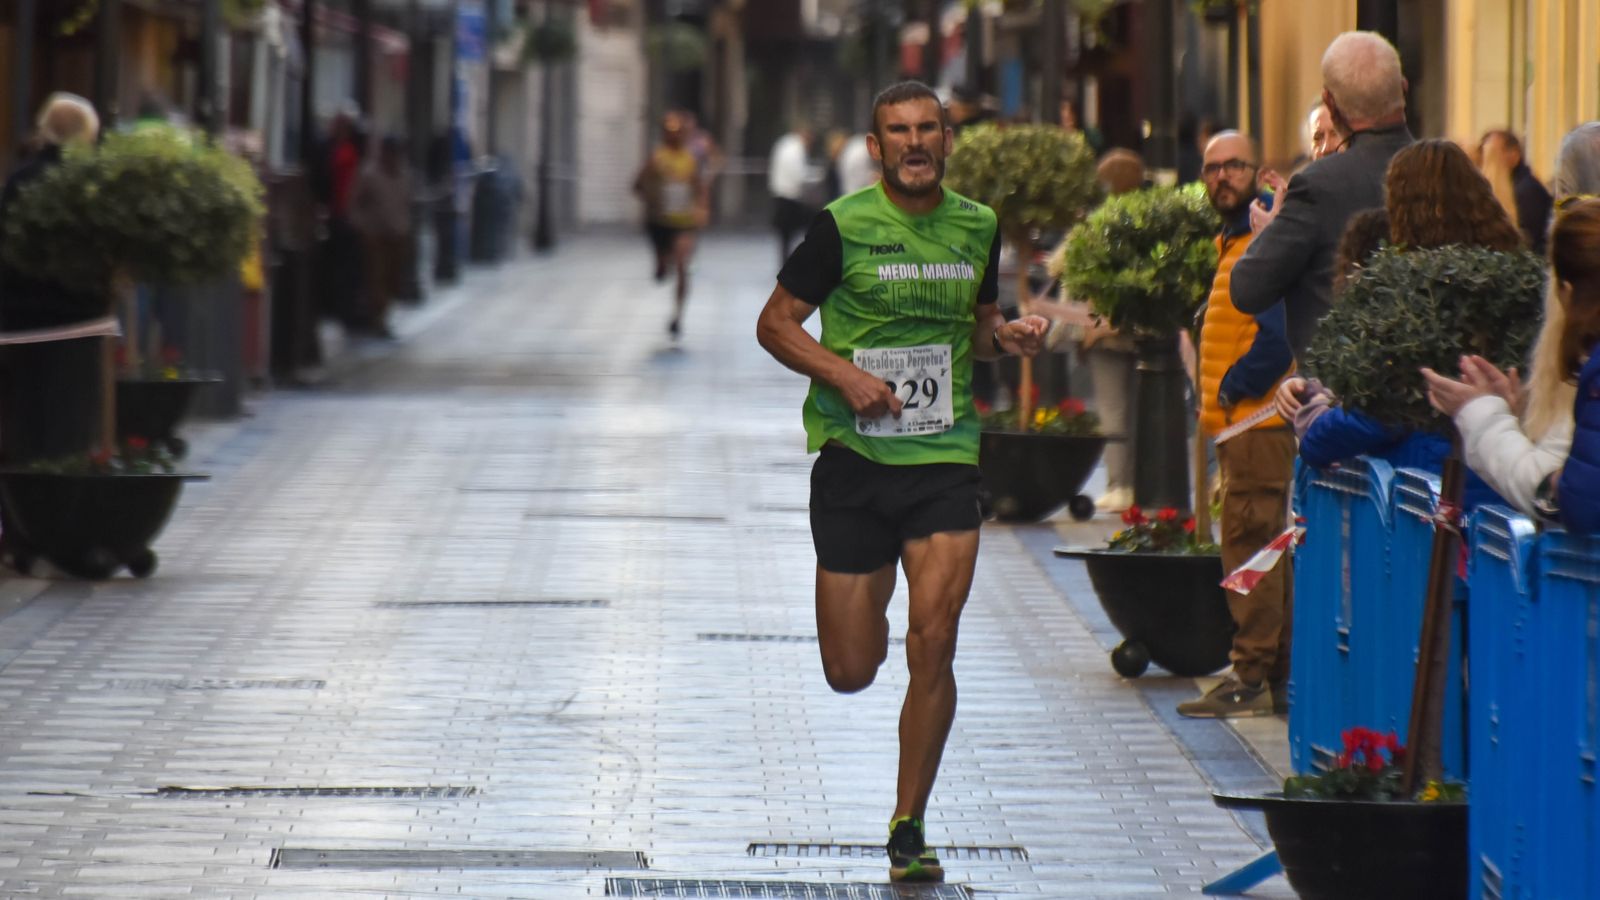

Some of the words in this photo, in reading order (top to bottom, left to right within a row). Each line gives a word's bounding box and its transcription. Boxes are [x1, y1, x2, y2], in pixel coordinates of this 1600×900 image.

[869, 243, 905, 256] HOKA
[878, 264, 919, 280] MEDIO
[922, 260, 975, 280] MARATÓN
